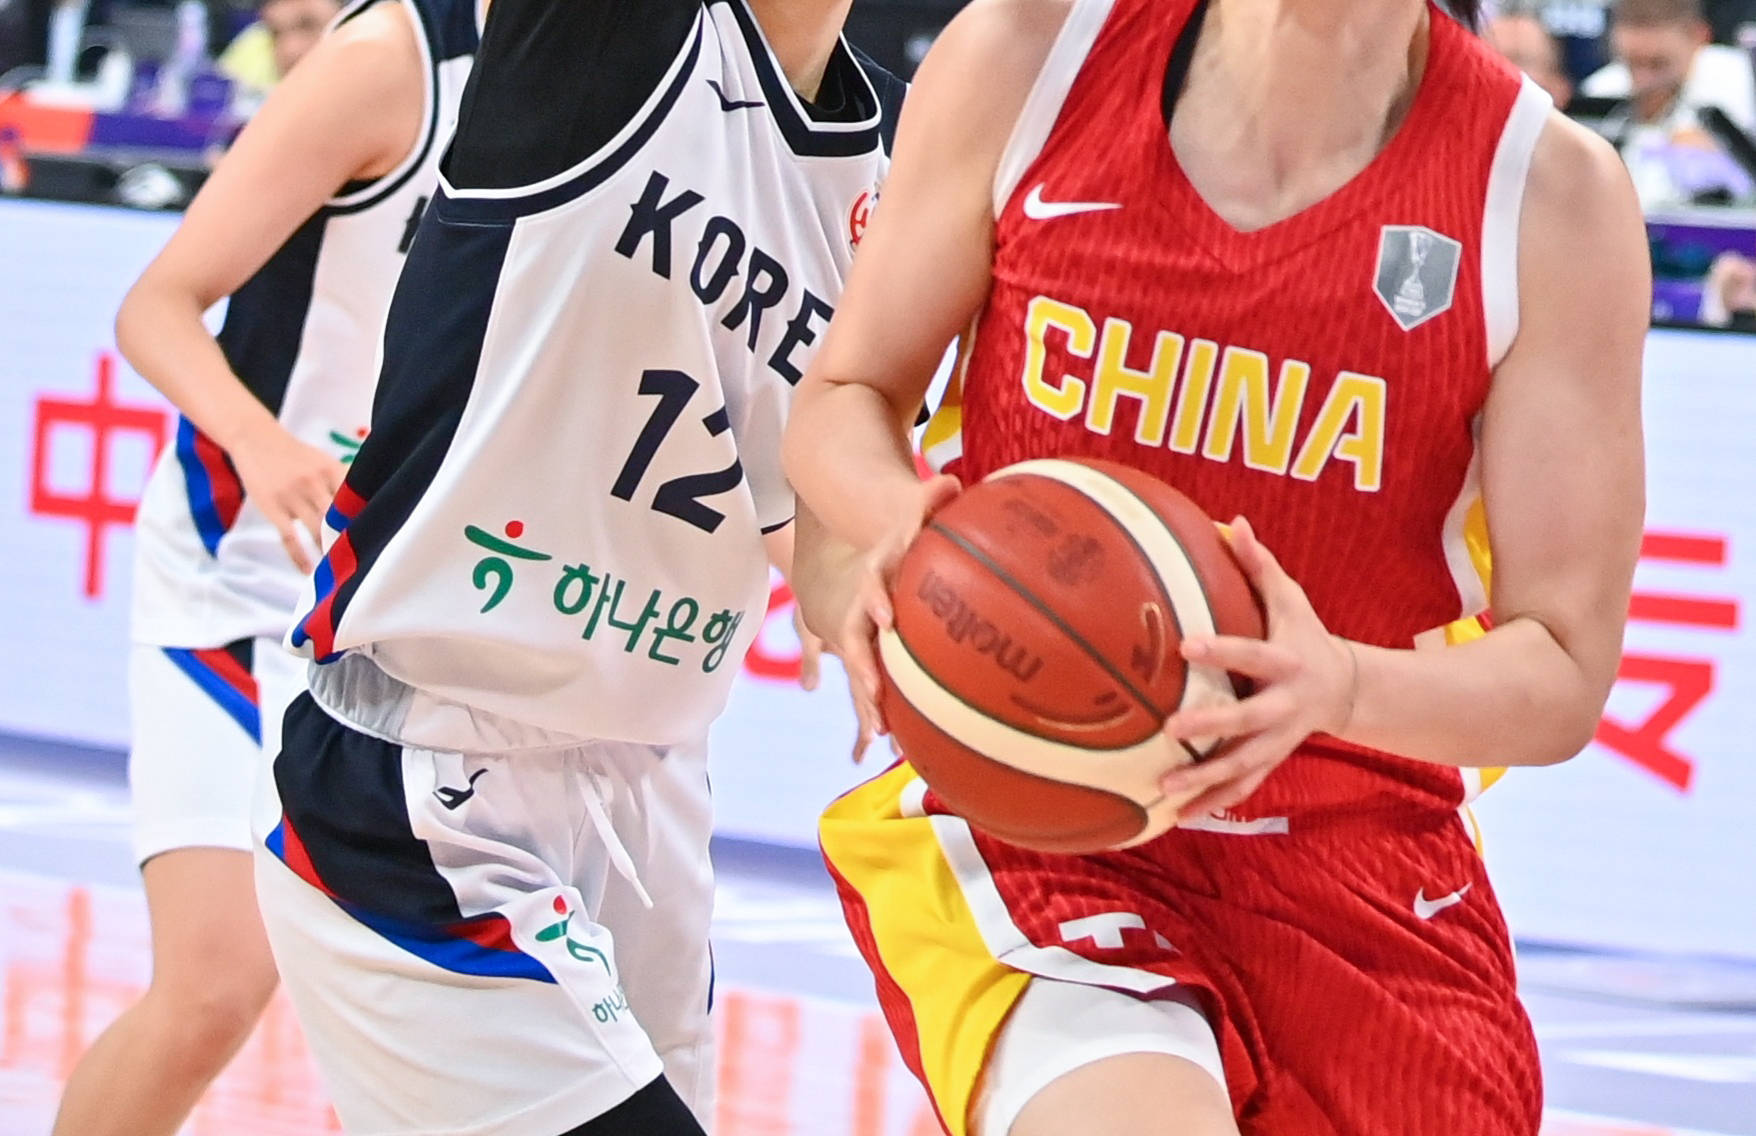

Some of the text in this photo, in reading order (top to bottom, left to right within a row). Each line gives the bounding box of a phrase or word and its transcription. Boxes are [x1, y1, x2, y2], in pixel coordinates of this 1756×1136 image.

[615, 170, 834, 386] KORE
[610, 369, 744, 534] 12
[1022, 295, 1387, 493] CHINA
[553, 563, 745, 673] 하나은행
[917, 569, 1045, 683] molten
